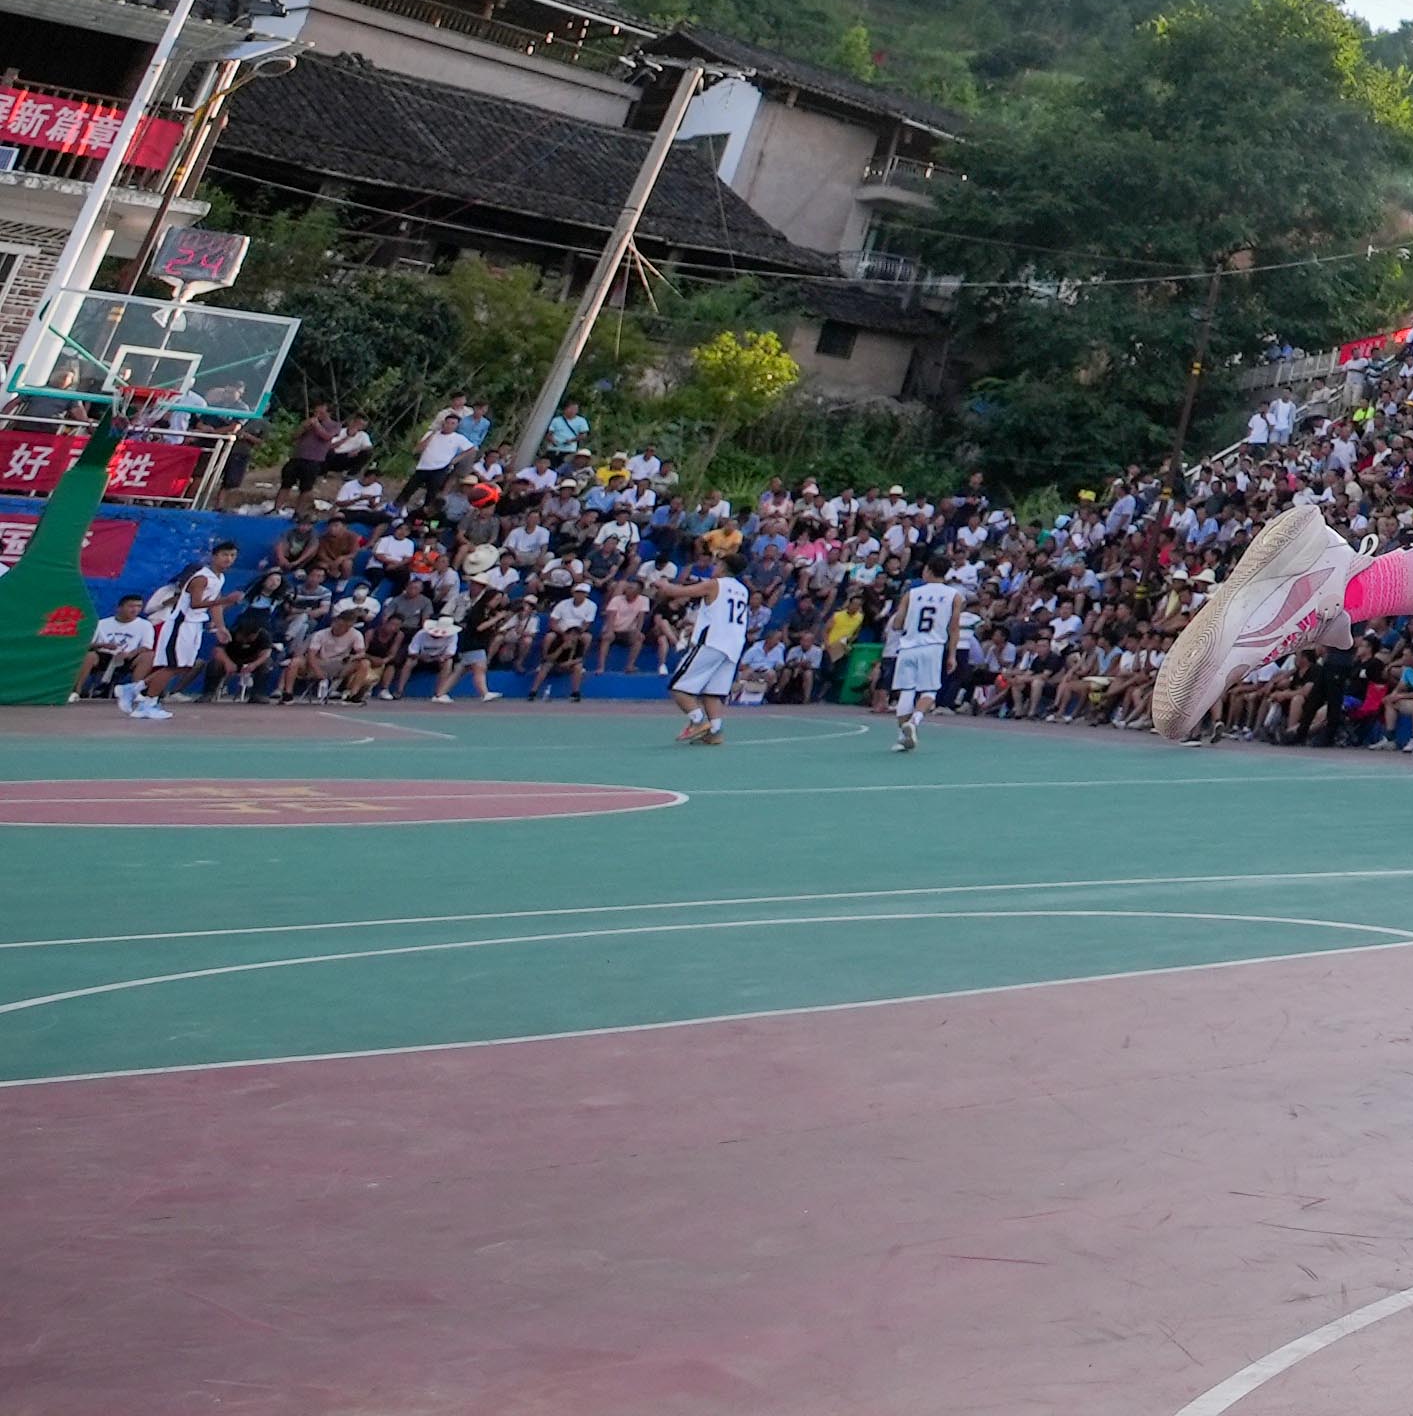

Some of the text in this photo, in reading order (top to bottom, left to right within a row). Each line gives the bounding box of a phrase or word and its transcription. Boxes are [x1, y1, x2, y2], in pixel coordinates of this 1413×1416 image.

[163, 248, 225, 279] 24
[727, 598, 747, 625] 12
[917, 606, 936, 633] 6
